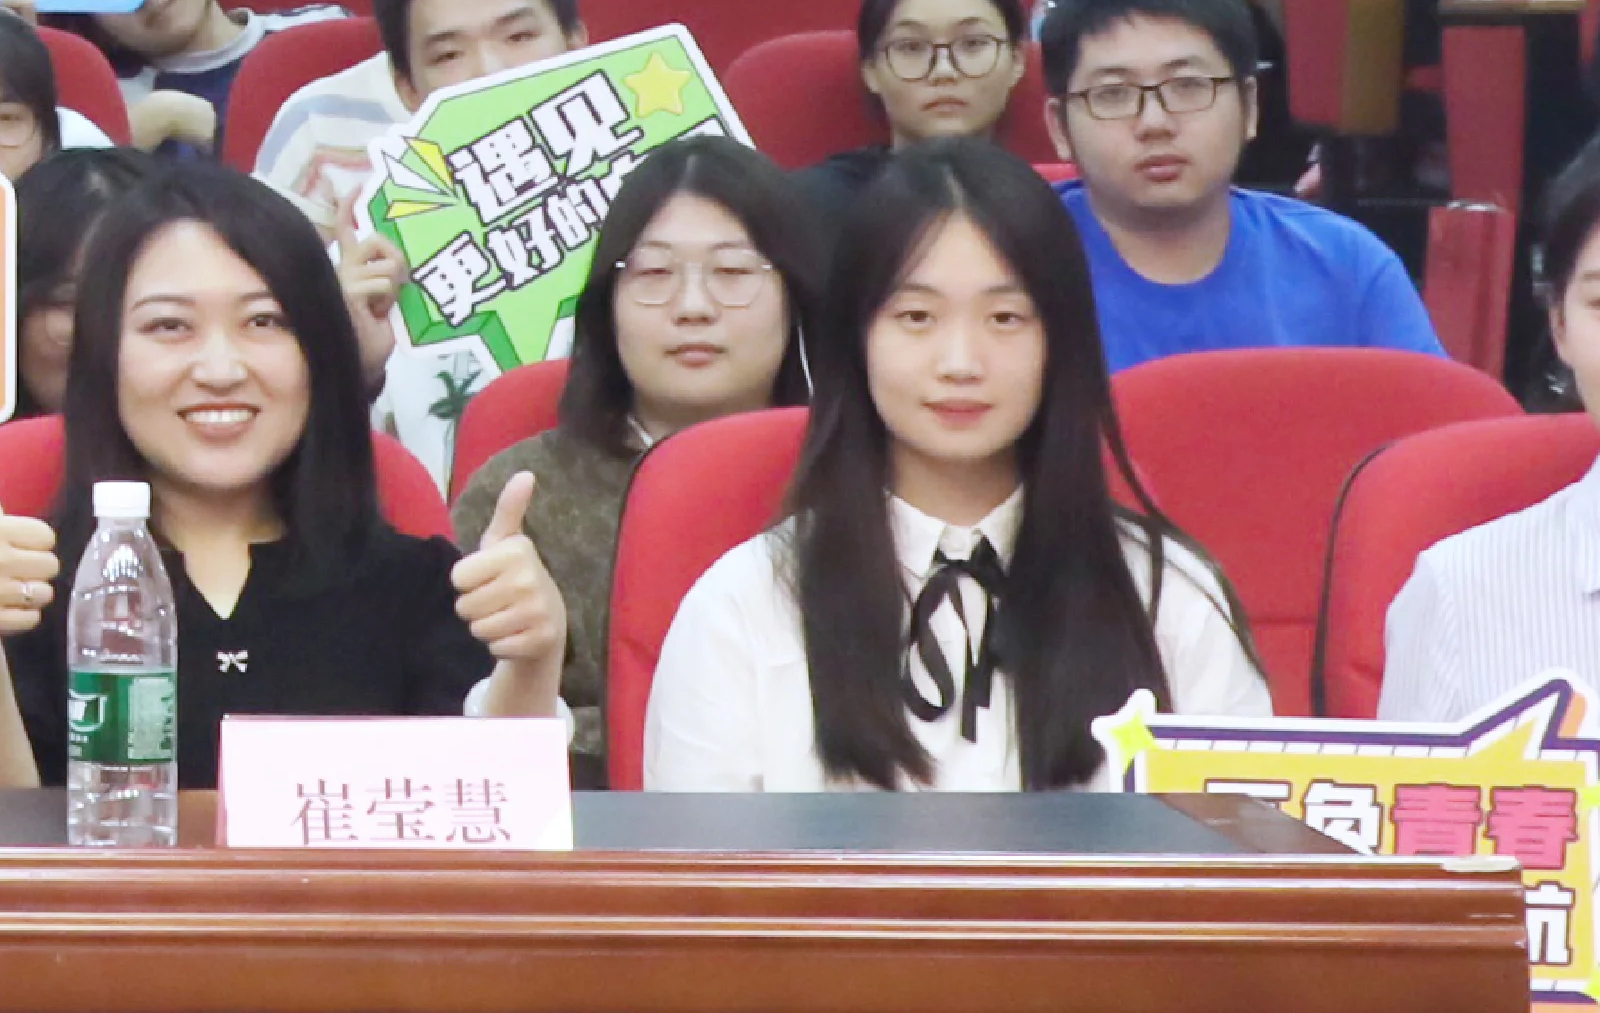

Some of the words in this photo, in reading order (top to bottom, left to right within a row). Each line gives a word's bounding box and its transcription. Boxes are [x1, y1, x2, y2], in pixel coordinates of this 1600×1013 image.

[446, 69, 644, 227] 遇见
[410, 148, 645, 329] 更好的
[290, 776, 513, 847] 崔莹慧
